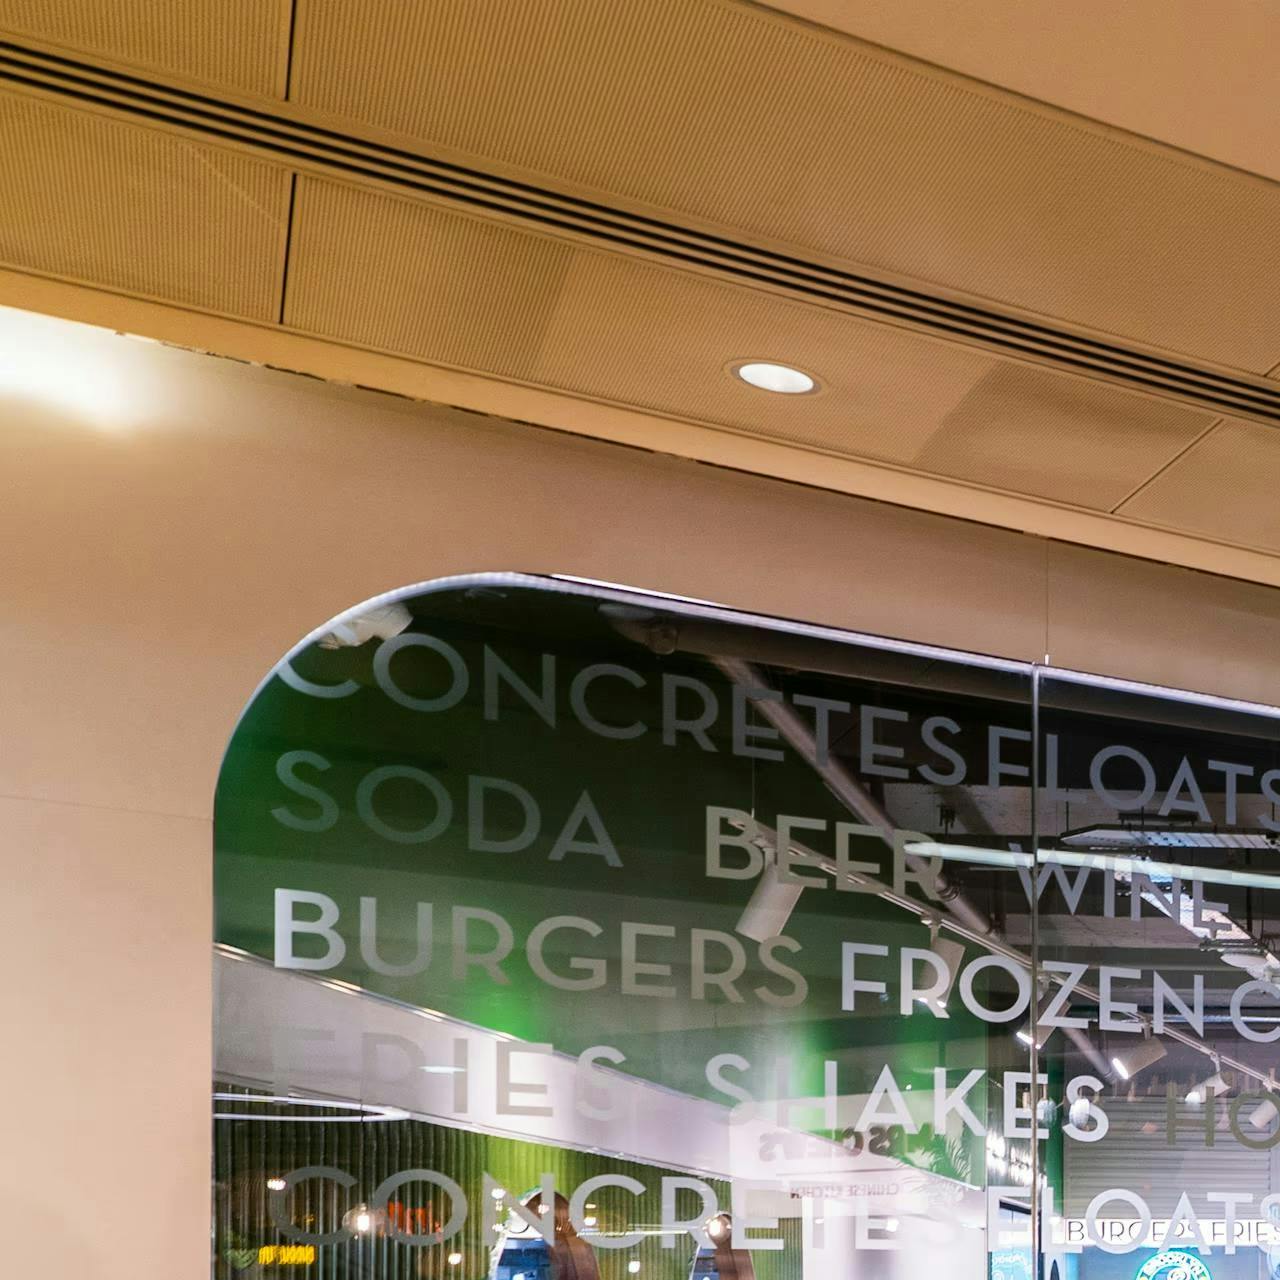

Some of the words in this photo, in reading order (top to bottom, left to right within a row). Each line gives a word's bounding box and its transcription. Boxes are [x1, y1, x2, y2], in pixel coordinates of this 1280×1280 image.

[270, 750, 624, 867] SODA
[705, 805, 944, 900] BEER
[1009, 842, 1232, 932] WINE
[274, 888, 808, 1007] BURGERS
[841, 941, 1203, 1039] FROZEN
[704, 1053, 1109, 1143] SHAKES
